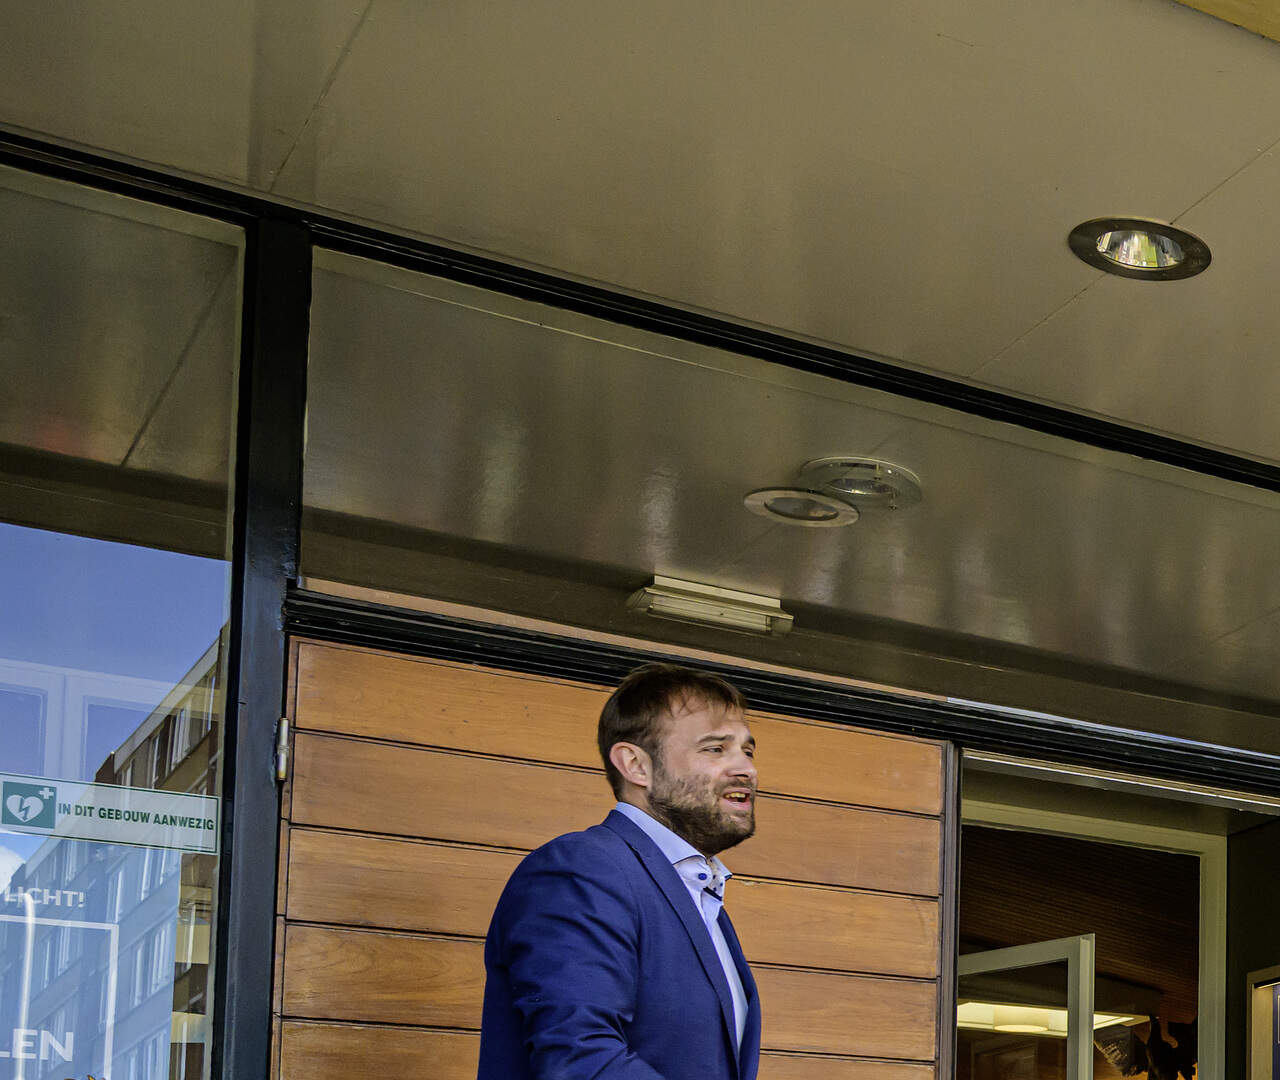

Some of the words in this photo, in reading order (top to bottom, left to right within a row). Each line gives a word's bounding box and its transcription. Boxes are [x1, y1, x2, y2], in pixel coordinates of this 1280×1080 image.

[58, 803, 71, 815] IN
[74, 805, 95, 817] DIT
[98, 808, 150, 823] GEBOUW
[153, 814, 214, 830] AANWEZIG
